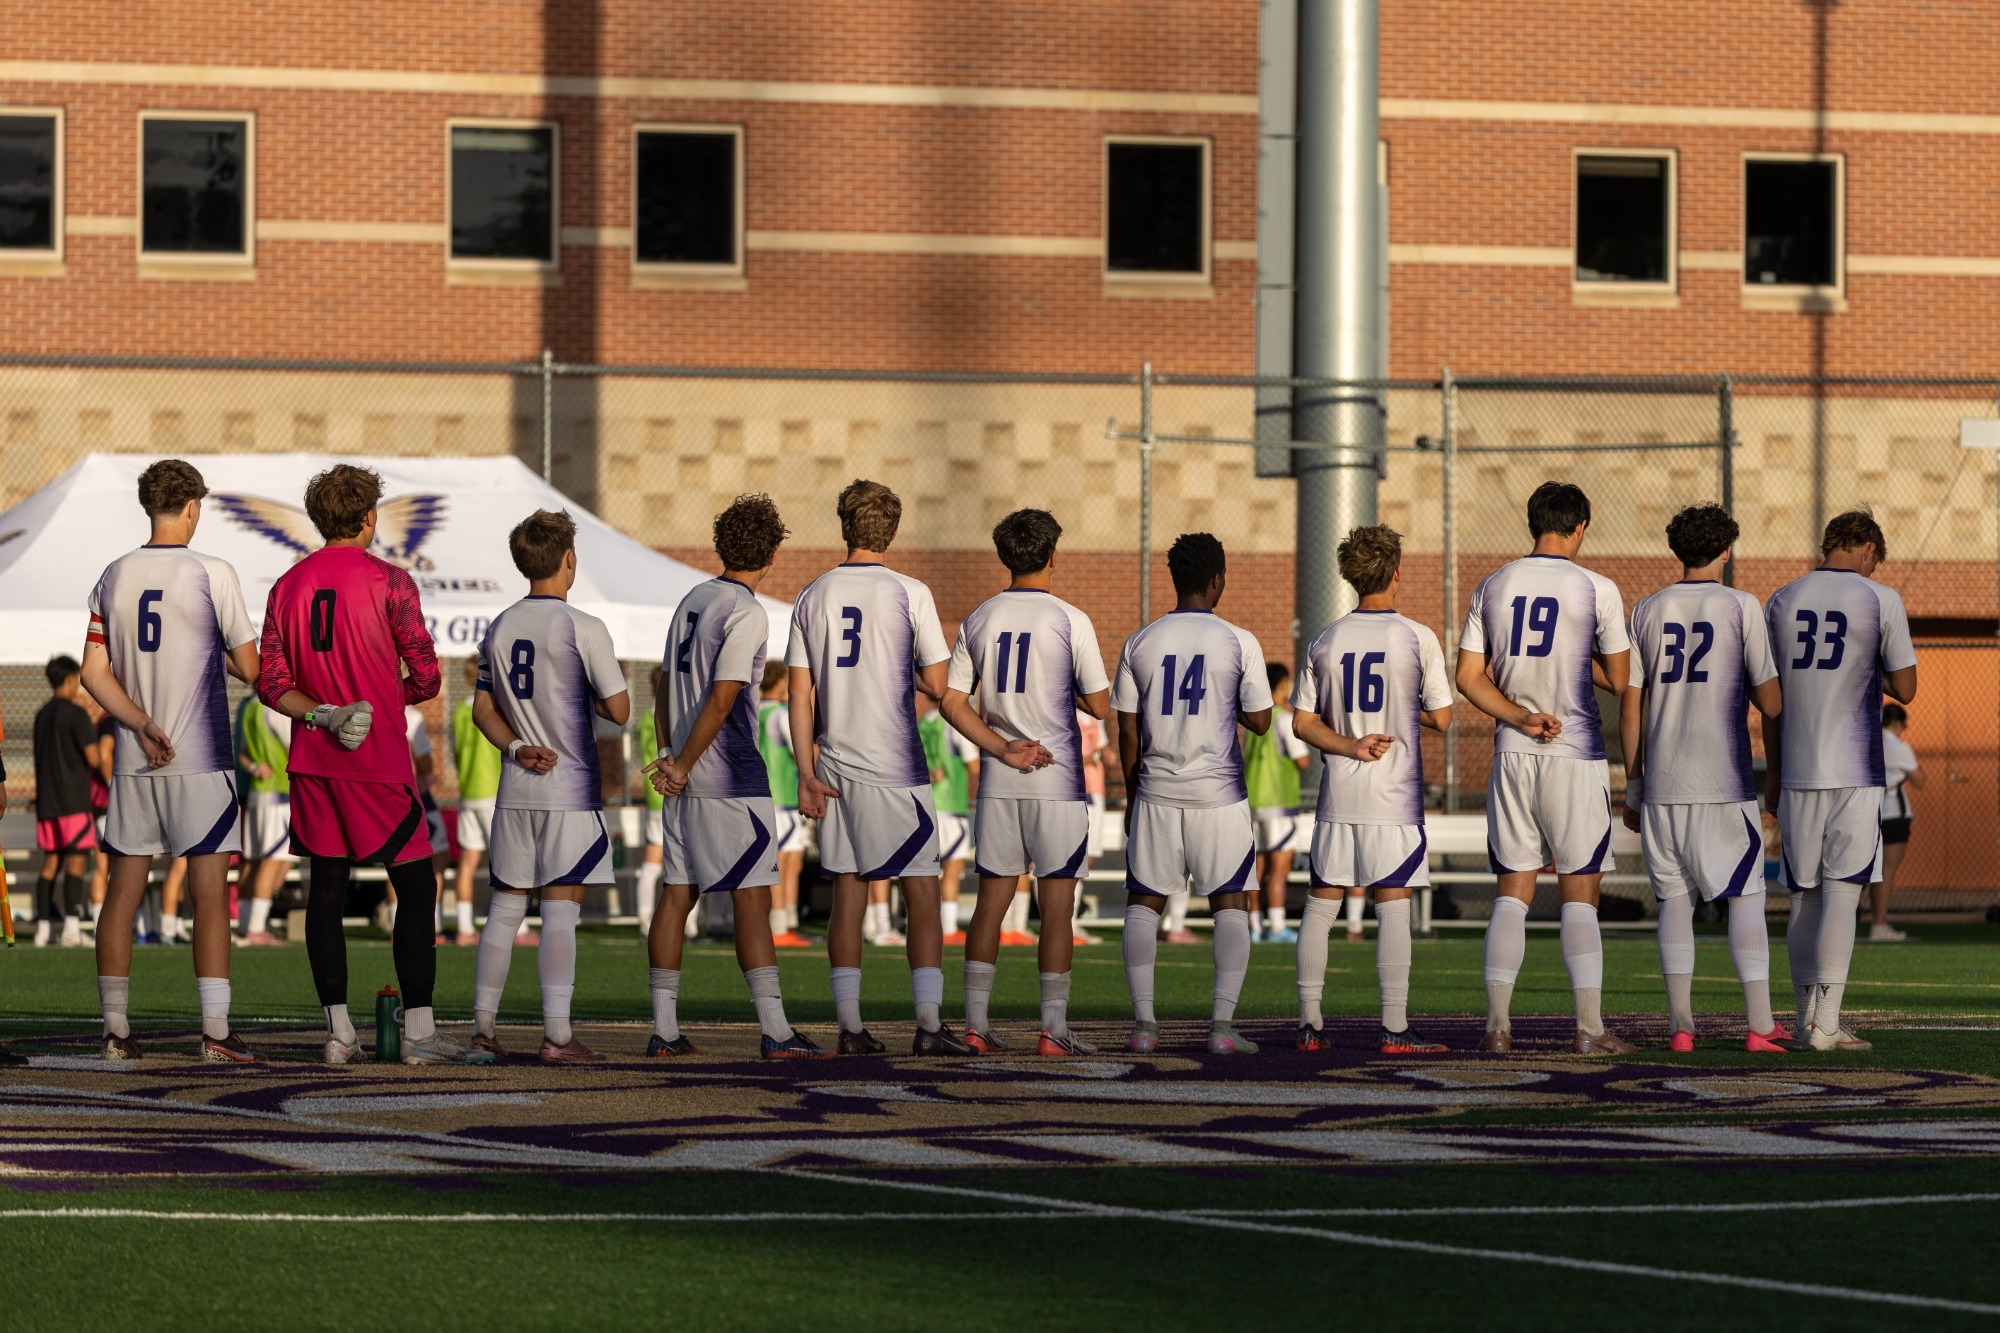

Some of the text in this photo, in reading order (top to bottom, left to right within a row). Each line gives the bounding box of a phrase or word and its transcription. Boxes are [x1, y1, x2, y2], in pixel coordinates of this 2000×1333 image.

[138, 589, 163, 653] 6
[310, 588, 337, 653] 0
[676, 610, 700, 674] 2
[837, 606, 863, 668] 3
[1510, 595, 1559, 657] 19
[1792, 609, 1847, 671] 33
[509, 638, 535, 700] 8
[996, 631, 1031, 694] 11
[1340, 651, 1386, 713] 16
[1660, 621, 1714, 684] 32
[1160, 654, 1206, 716] 14
